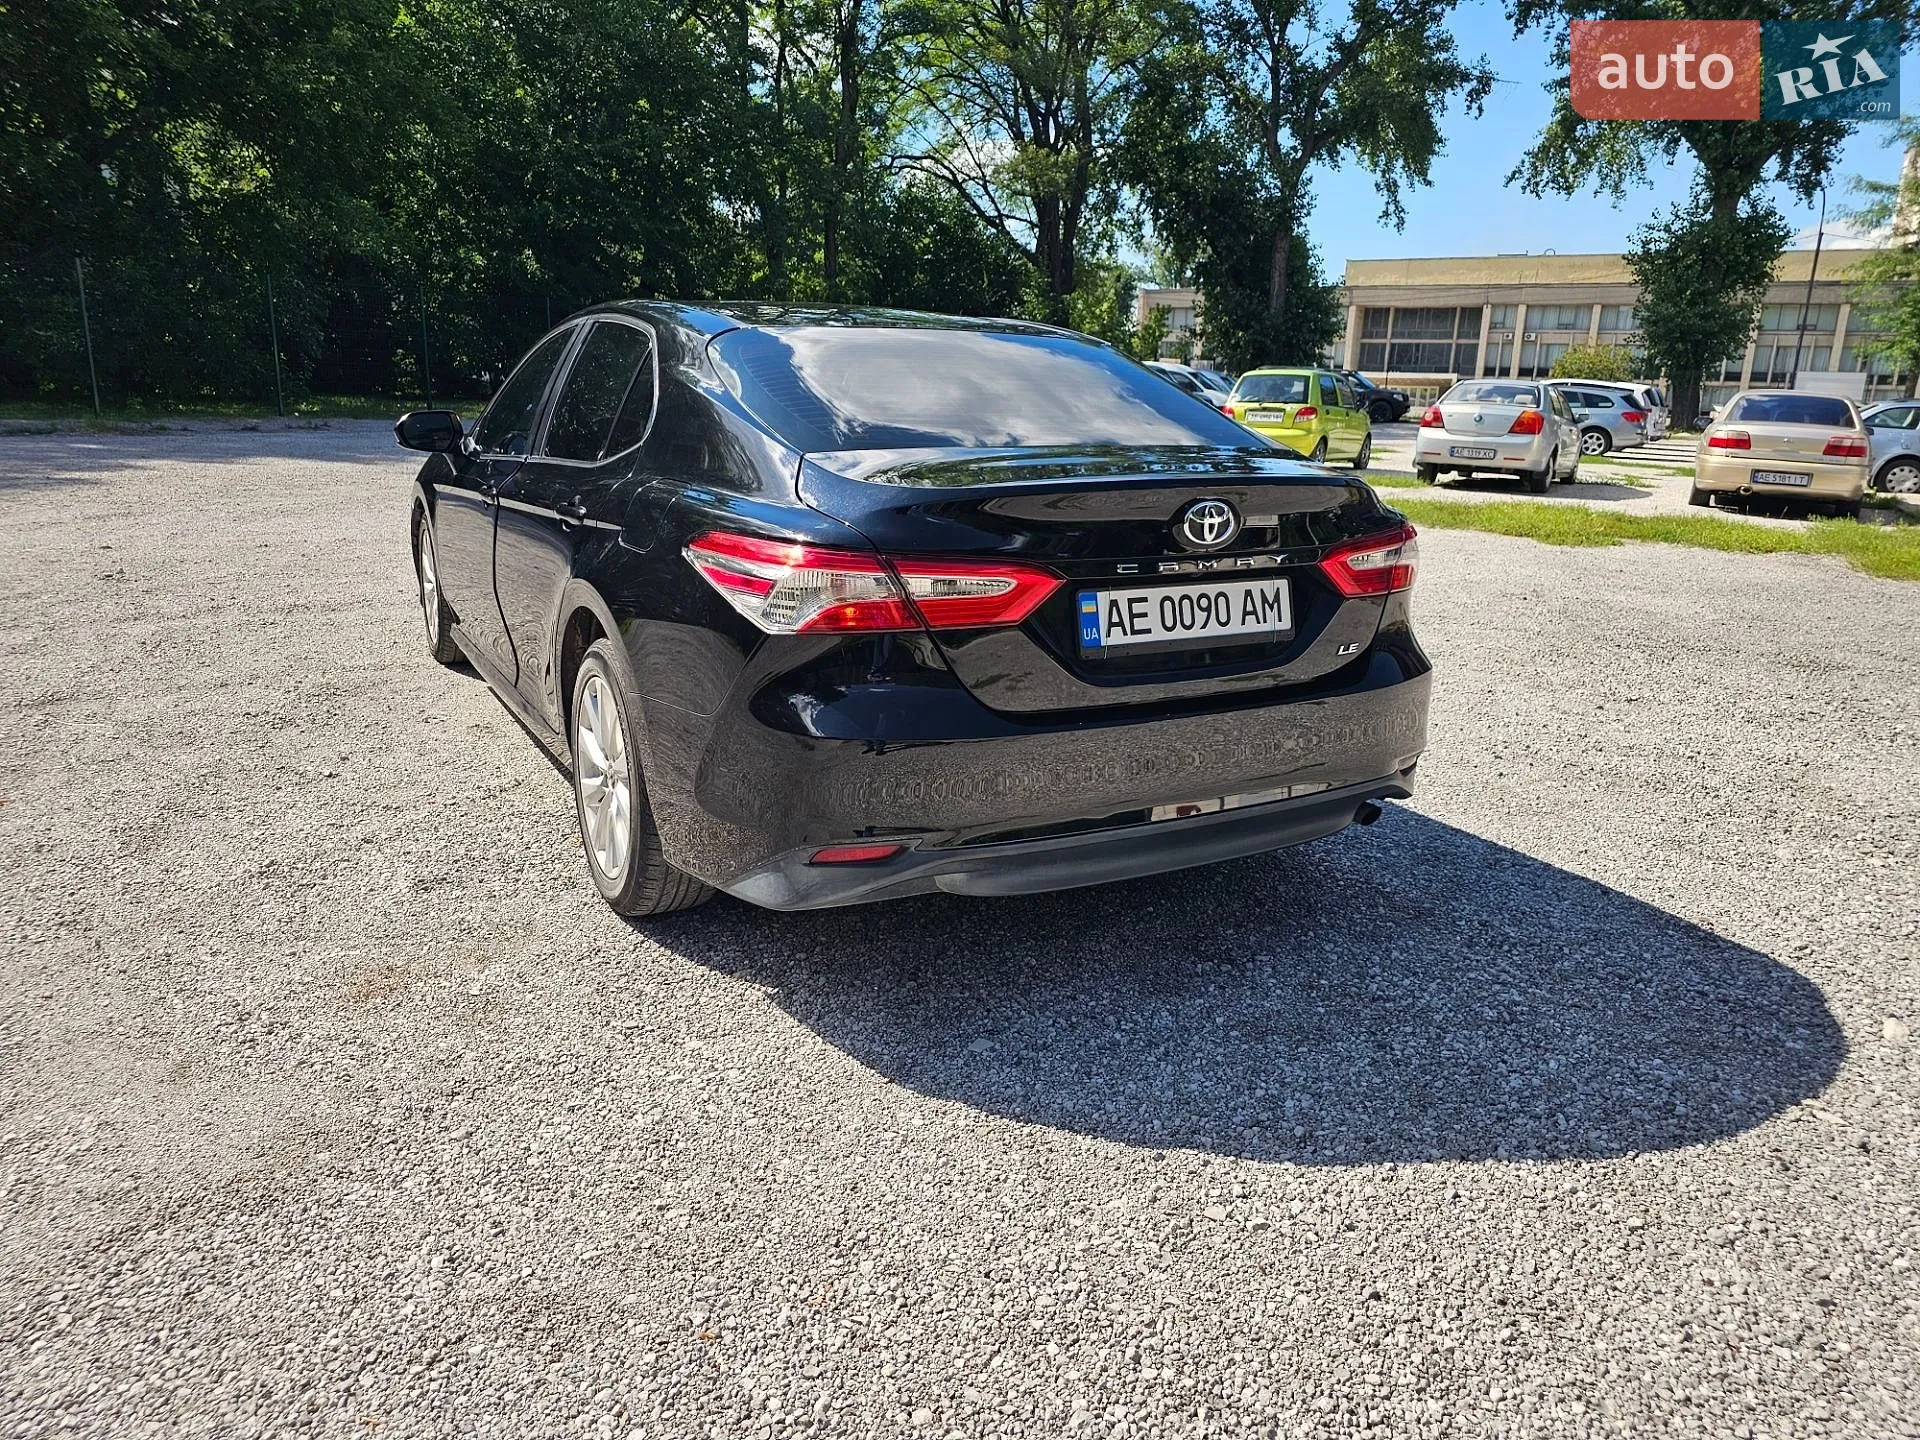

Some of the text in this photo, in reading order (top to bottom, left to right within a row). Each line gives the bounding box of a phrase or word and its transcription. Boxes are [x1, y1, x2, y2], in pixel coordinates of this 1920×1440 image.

[1455, 448, 1465, 456] AE
[1482, 450, 1493, 458] XC
[1759, 473, 1771, 481] AE
[1772, 474, 1791, 483] 5181
[1117, 554, 1289, 573] CAMRY
[1106, 587, 1283, 639] AE 0090 AM
[1083, 628, 1099, 641] UA
[1337, 642, 1360, 656] LE
